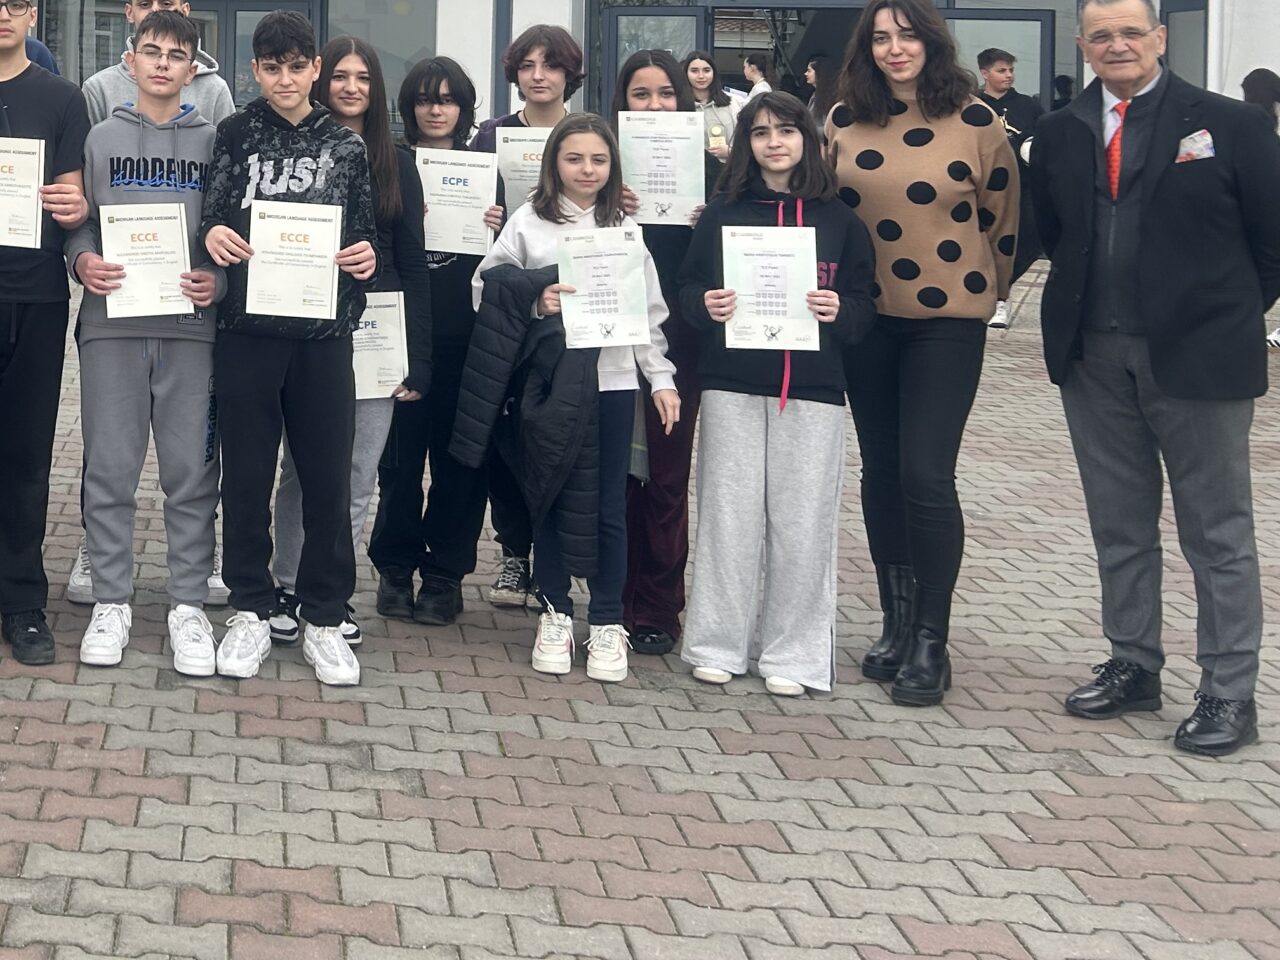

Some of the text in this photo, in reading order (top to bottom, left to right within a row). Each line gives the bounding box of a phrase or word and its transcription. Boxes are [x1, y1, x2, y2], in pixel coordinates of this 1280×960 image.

[522, 153, 543, 162] ECC
[109, 156, 209, 193] HOODRICH
[442, 176, 469, 187] ECPE
[130, 232, 159, 243] ECCE
[280, 232, 310, 244] ECCE
[359, 320, 378, 330] CPE
